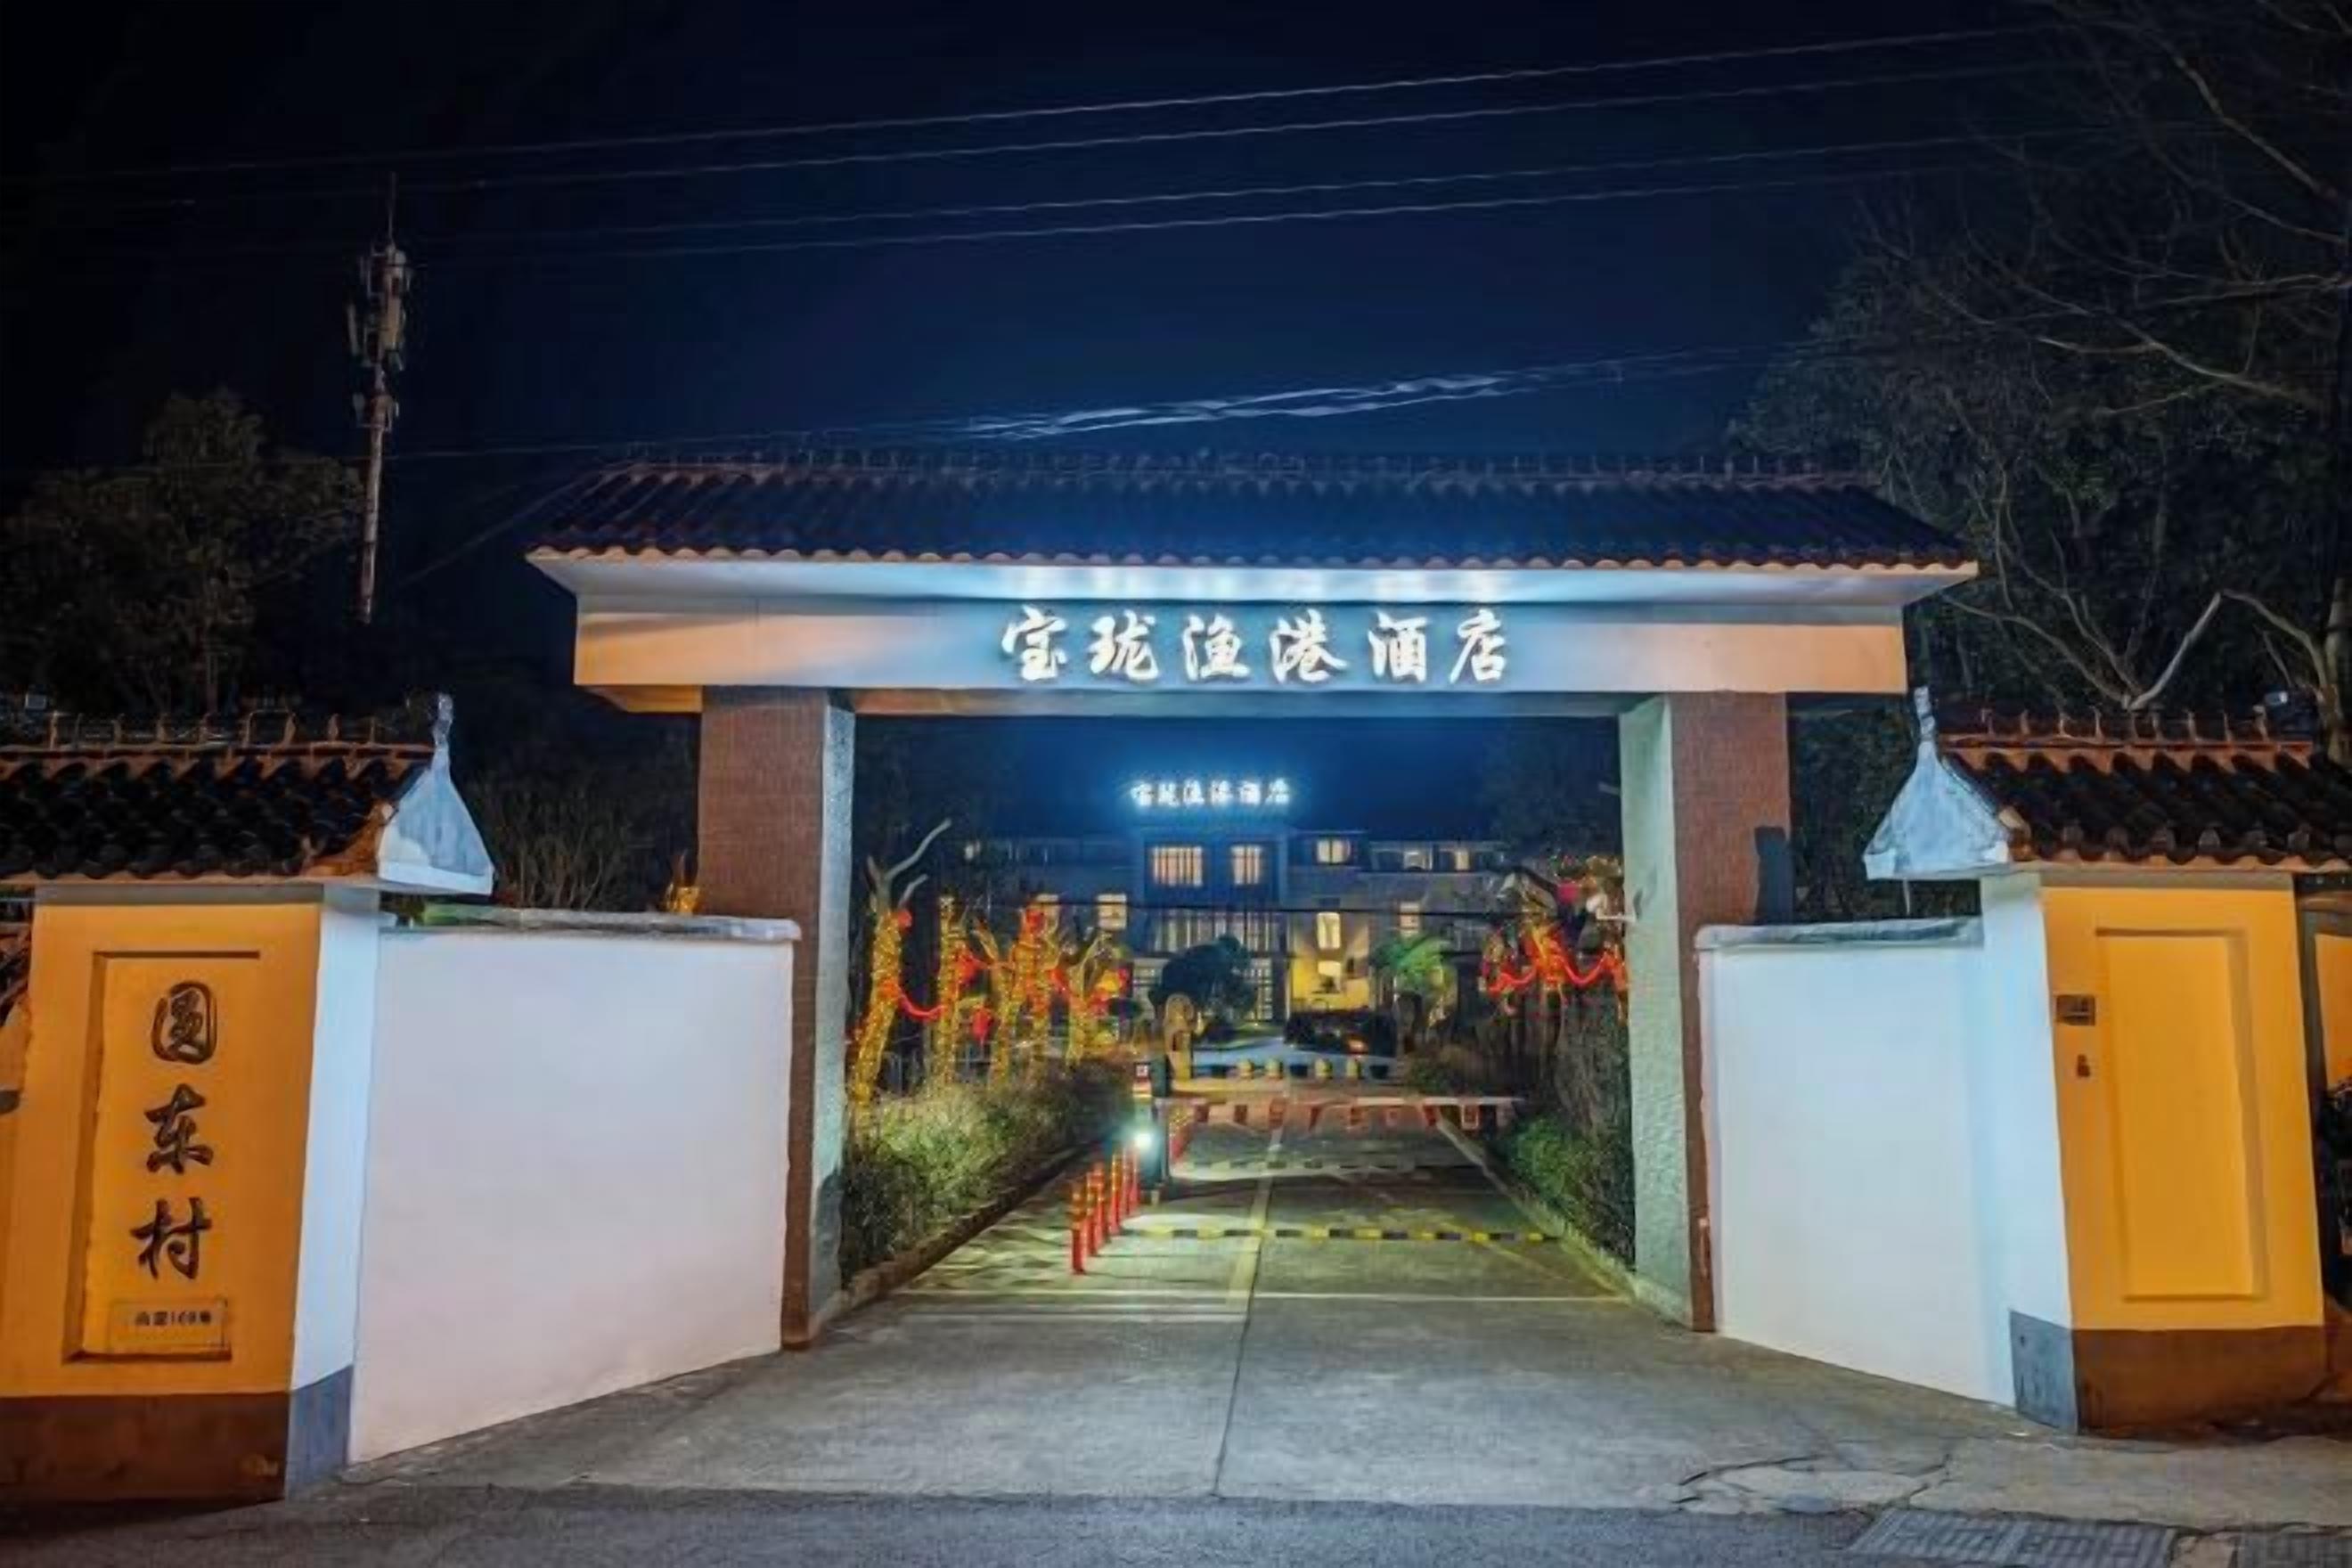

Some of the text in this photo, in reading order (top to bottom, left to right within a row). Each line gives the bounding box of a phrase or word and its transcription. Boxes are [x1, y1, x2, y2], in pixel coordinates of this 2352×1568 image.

[1001, 604, 1507, 683] 宝珑渔港酒店
